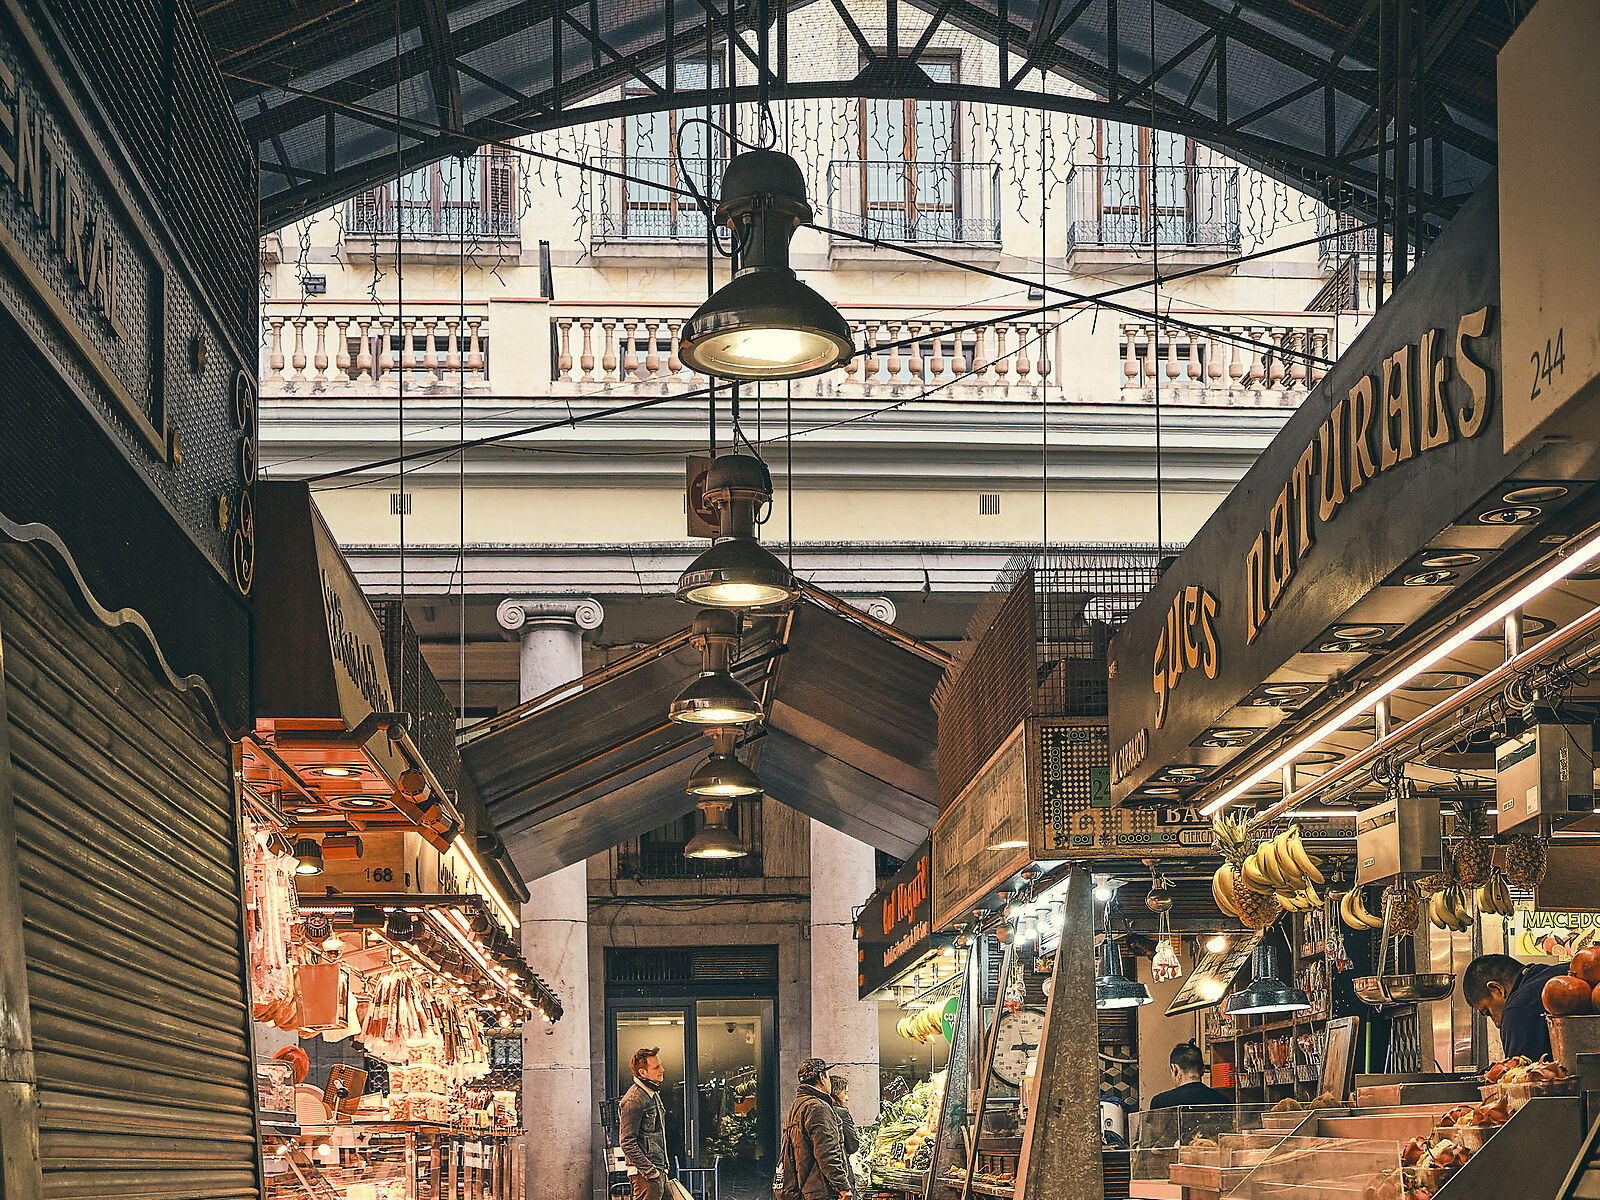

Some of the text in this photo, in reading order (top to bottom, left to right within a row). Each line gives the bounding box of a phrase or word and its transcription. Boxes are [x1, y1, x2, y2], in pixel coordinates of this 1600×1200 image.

[1529, 327, 1567, 400] 244
[1165, 806, 1210, 823] BA
[363, 867, 393, 883] 168
